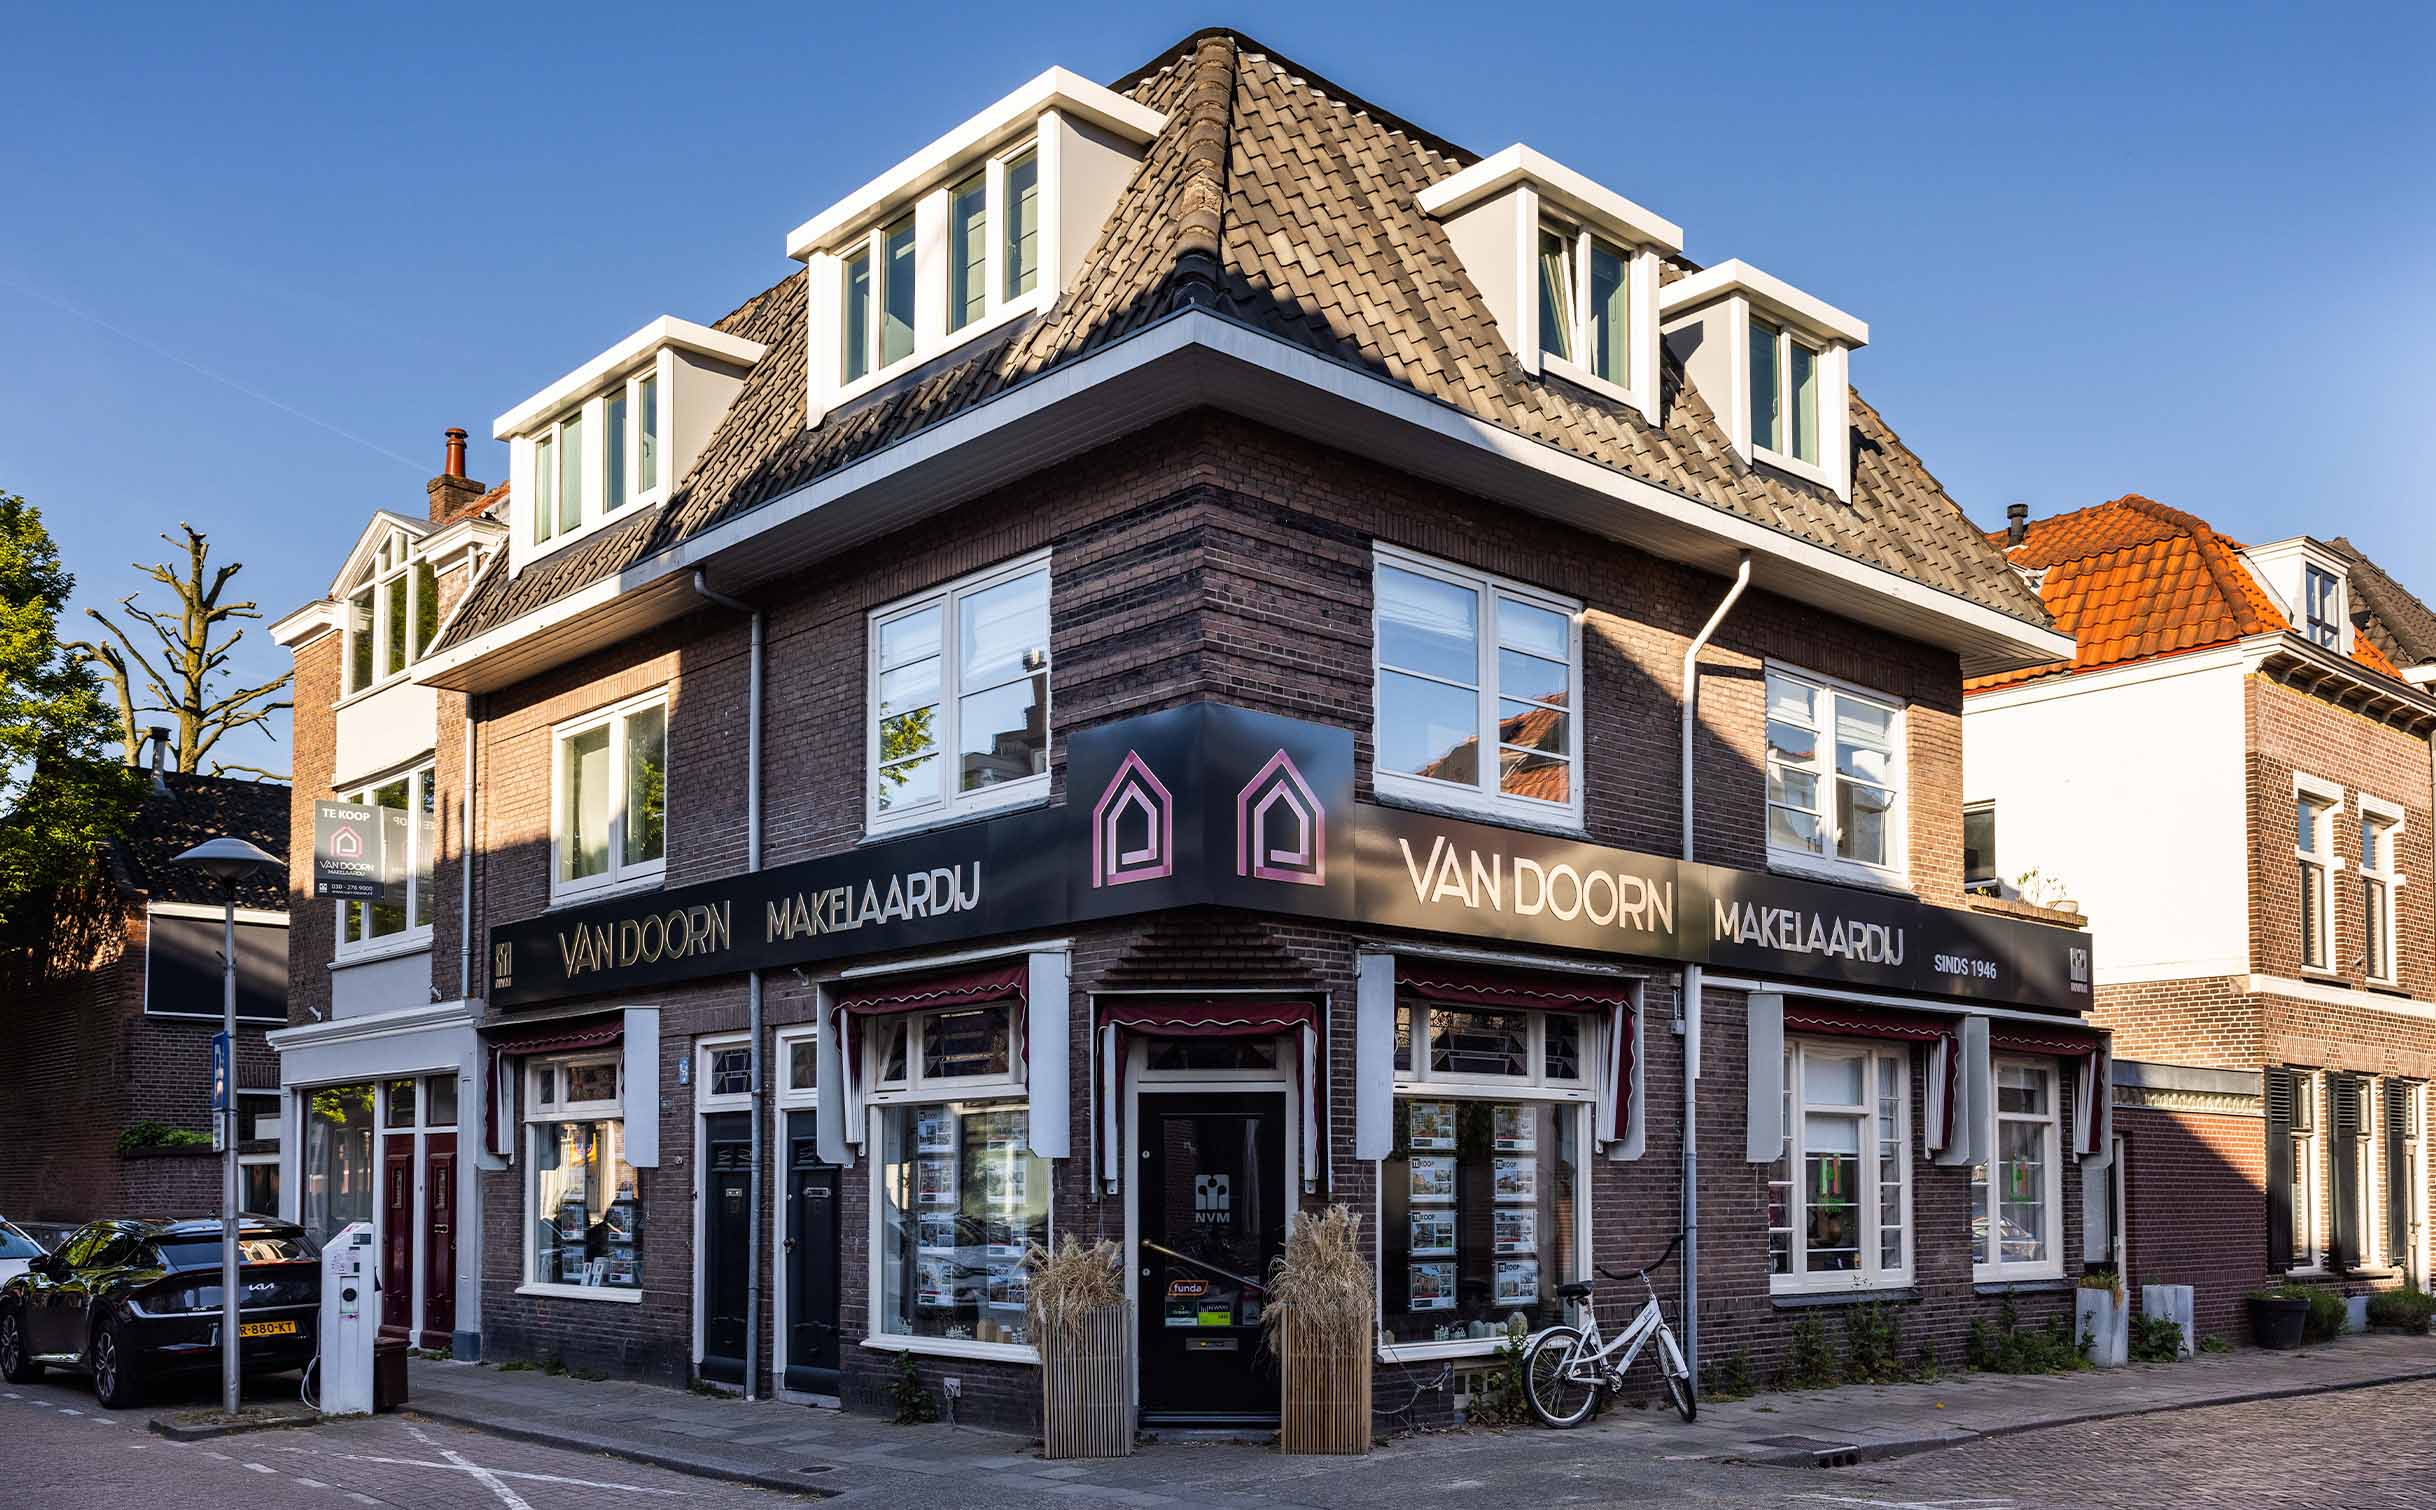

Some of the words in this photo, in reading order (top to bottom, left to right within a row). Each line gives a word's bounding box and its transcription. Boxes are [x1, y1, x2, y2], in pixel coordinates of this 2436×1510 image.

[322, 808, 337, 819] TE
[338, 810, 371, 822] KOOP
[319, 859, 339, 870] VAN
[340, 861, 375, 872] DOORN
[1399, 835, 1502, 912] VAN
[1514, 857, 1674, 935] DOORN
[767, 860, 981, 944] MAKELAARDIJ
[558, 920, 614, 980] VAN
[618, 899, 731, 968] DOORN
[1714, 898, 1905, 968] MAKELAARDIJ
[1934, 953, 1969, 976] SINDS
[1971, 960, 1998, 980] 1946
[1195, 1212, 1230, 1223] NVM
[1174, 1283, 1202, 1293] funda
